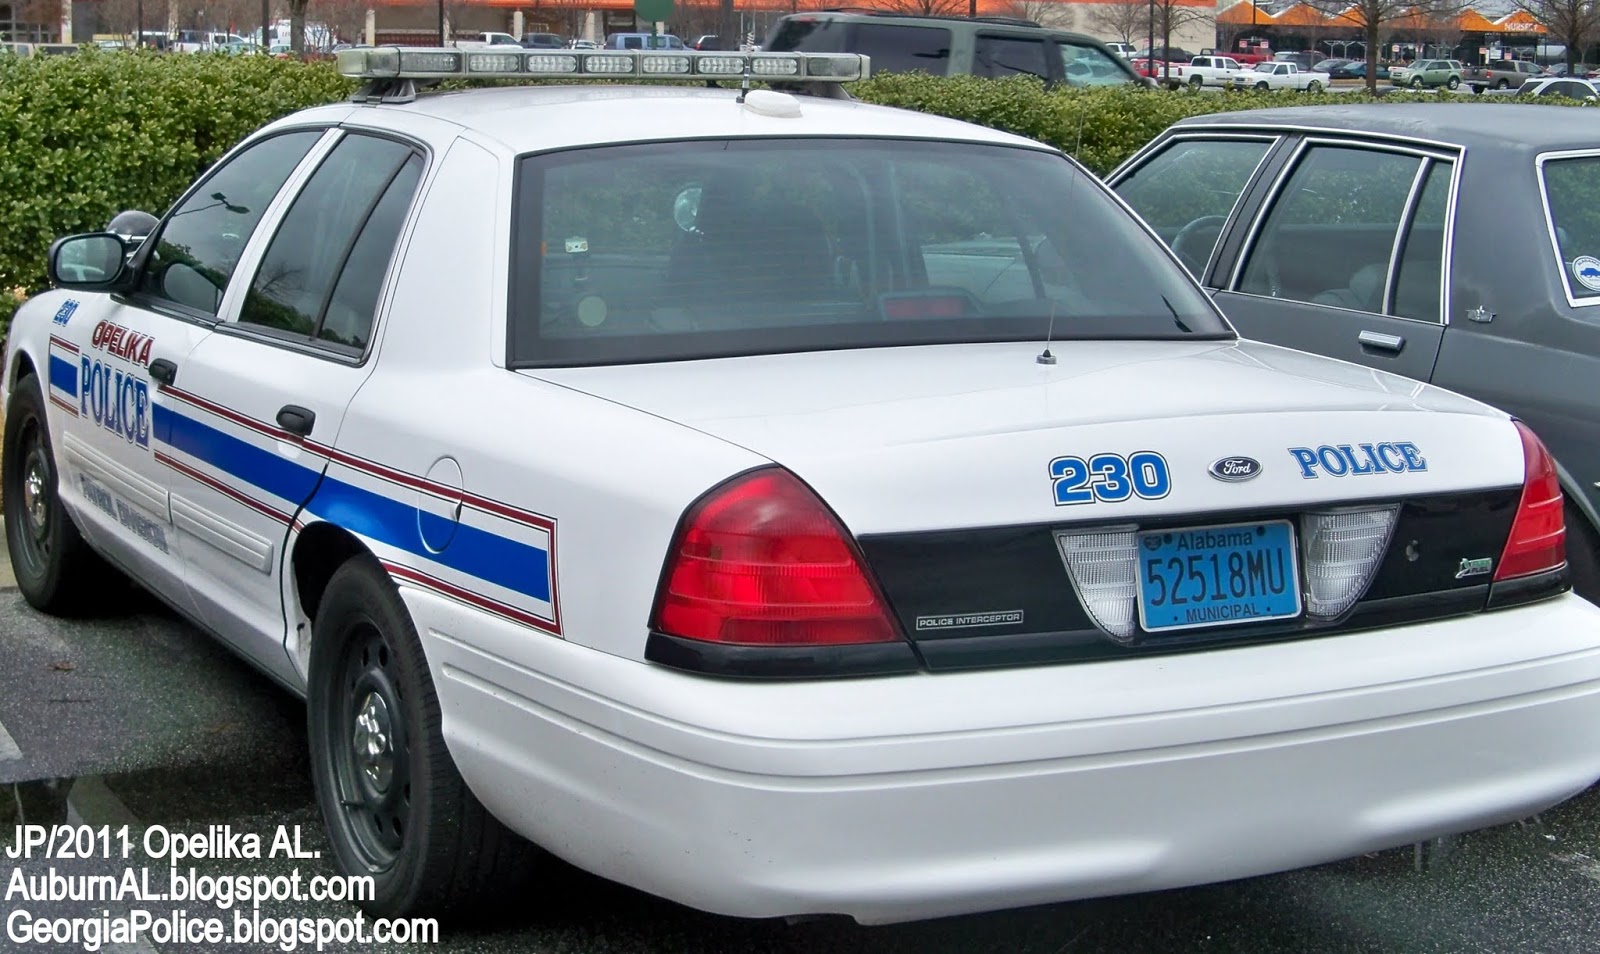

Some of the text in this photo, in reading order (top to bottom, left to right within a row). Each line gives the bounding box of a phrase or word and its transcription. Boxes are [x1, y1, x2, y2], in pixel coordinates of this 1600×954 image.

[92, 319, 155, 369] OPELIKA
[81, 353, 149, 451] POLICE
[1048, 450, 1172, 506] 230
[1222, 460, 1252, 475] Ford
[1288, 441, 1428, 480] POLICE
[1177, 532, 1253, 550] Alabama
[1147, 548, 1286, 607] 52518MU
[919, 613, 1020, 627] POLICE INTERCEPTOR
[1186, 602, 1260, 622] MUNICIPAL
